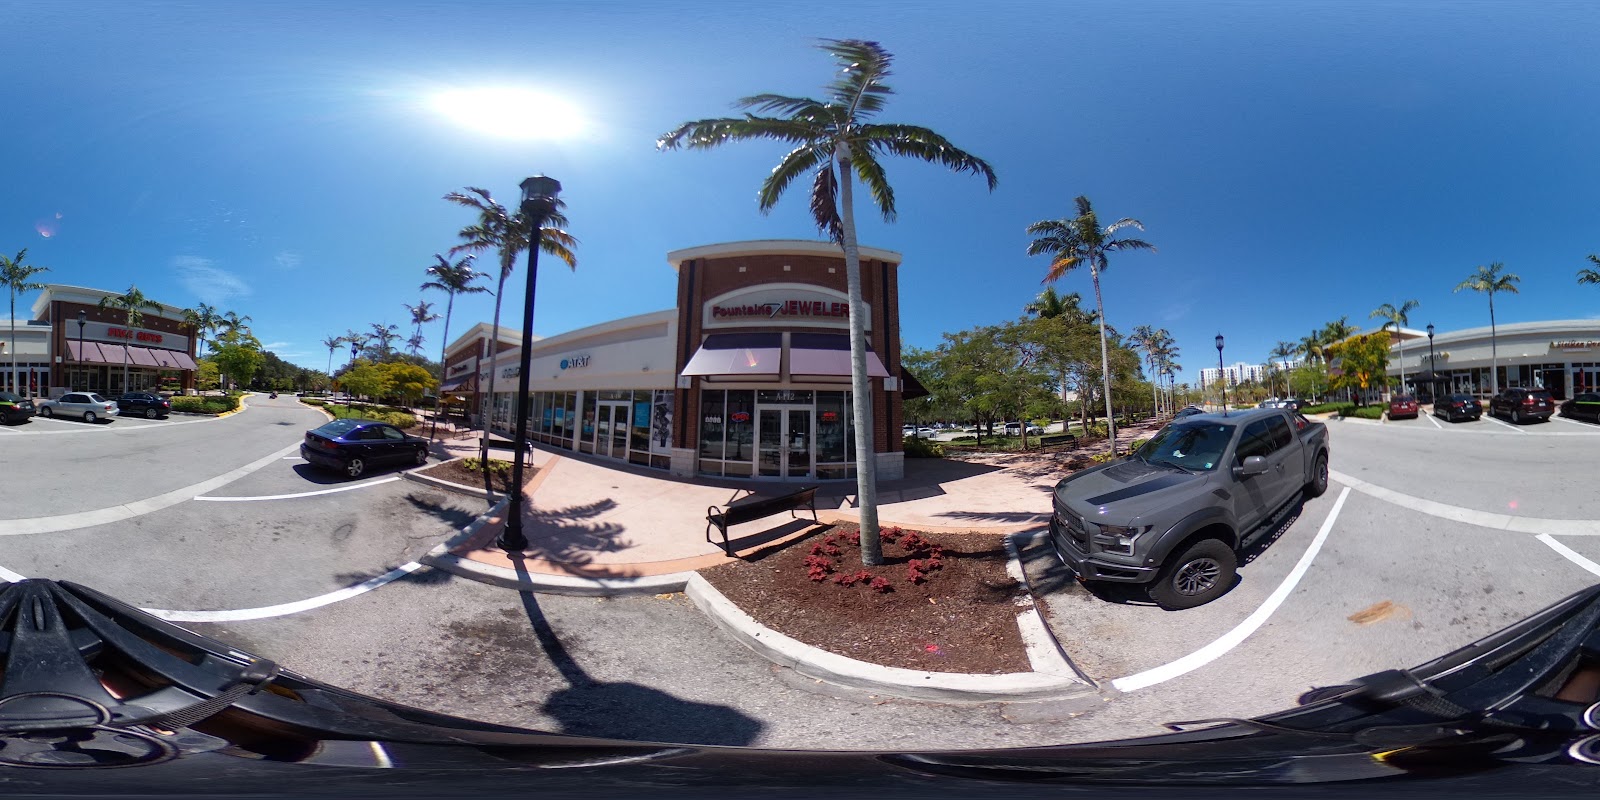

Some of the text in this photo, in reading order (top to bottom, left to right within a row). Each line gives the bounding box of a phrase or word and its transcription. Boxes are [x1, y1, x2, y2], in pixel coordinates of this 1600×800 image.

[712, 300, 850, 318] Fountains JEWELER
[136, 331, 163, 344] GUYS
[568, 355, 590, 369] AT&T
